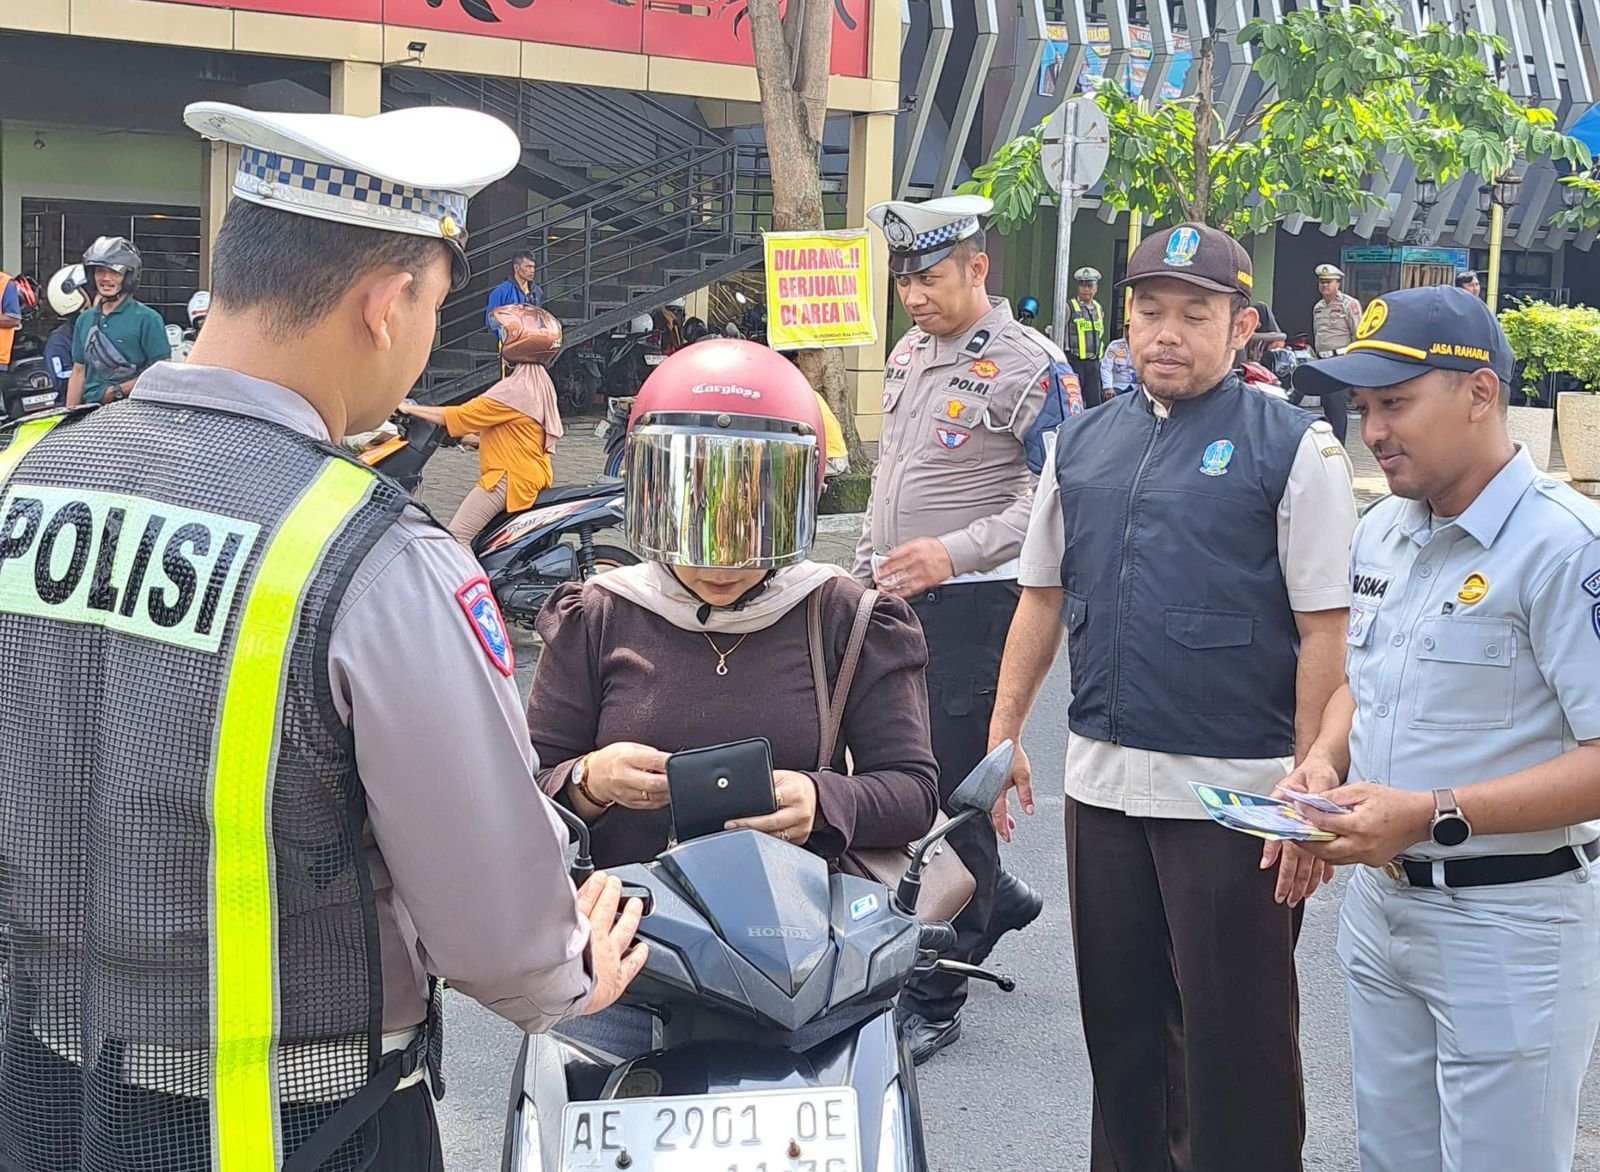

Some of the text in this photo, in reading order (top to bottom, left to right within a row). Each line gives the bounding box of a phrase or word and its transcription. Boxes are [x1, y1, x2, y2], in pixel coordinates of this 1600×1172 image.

[778, 275, 857, 298] BERJUALAN
[801, 302, 840, 325] AREA
[842, 302, 861, 323] INI
[1430, 343, 1452, 355] JASA
[691, 383, 761, 399] Cargloss
[948, 377, 990, 396] POLRI
[0, 497, 245, 635] POLISI
[747, 926, 812, 940] HONDA
[572, 1110, 622, 1151] AE
[653, 1104, 762, 1150] 2901
